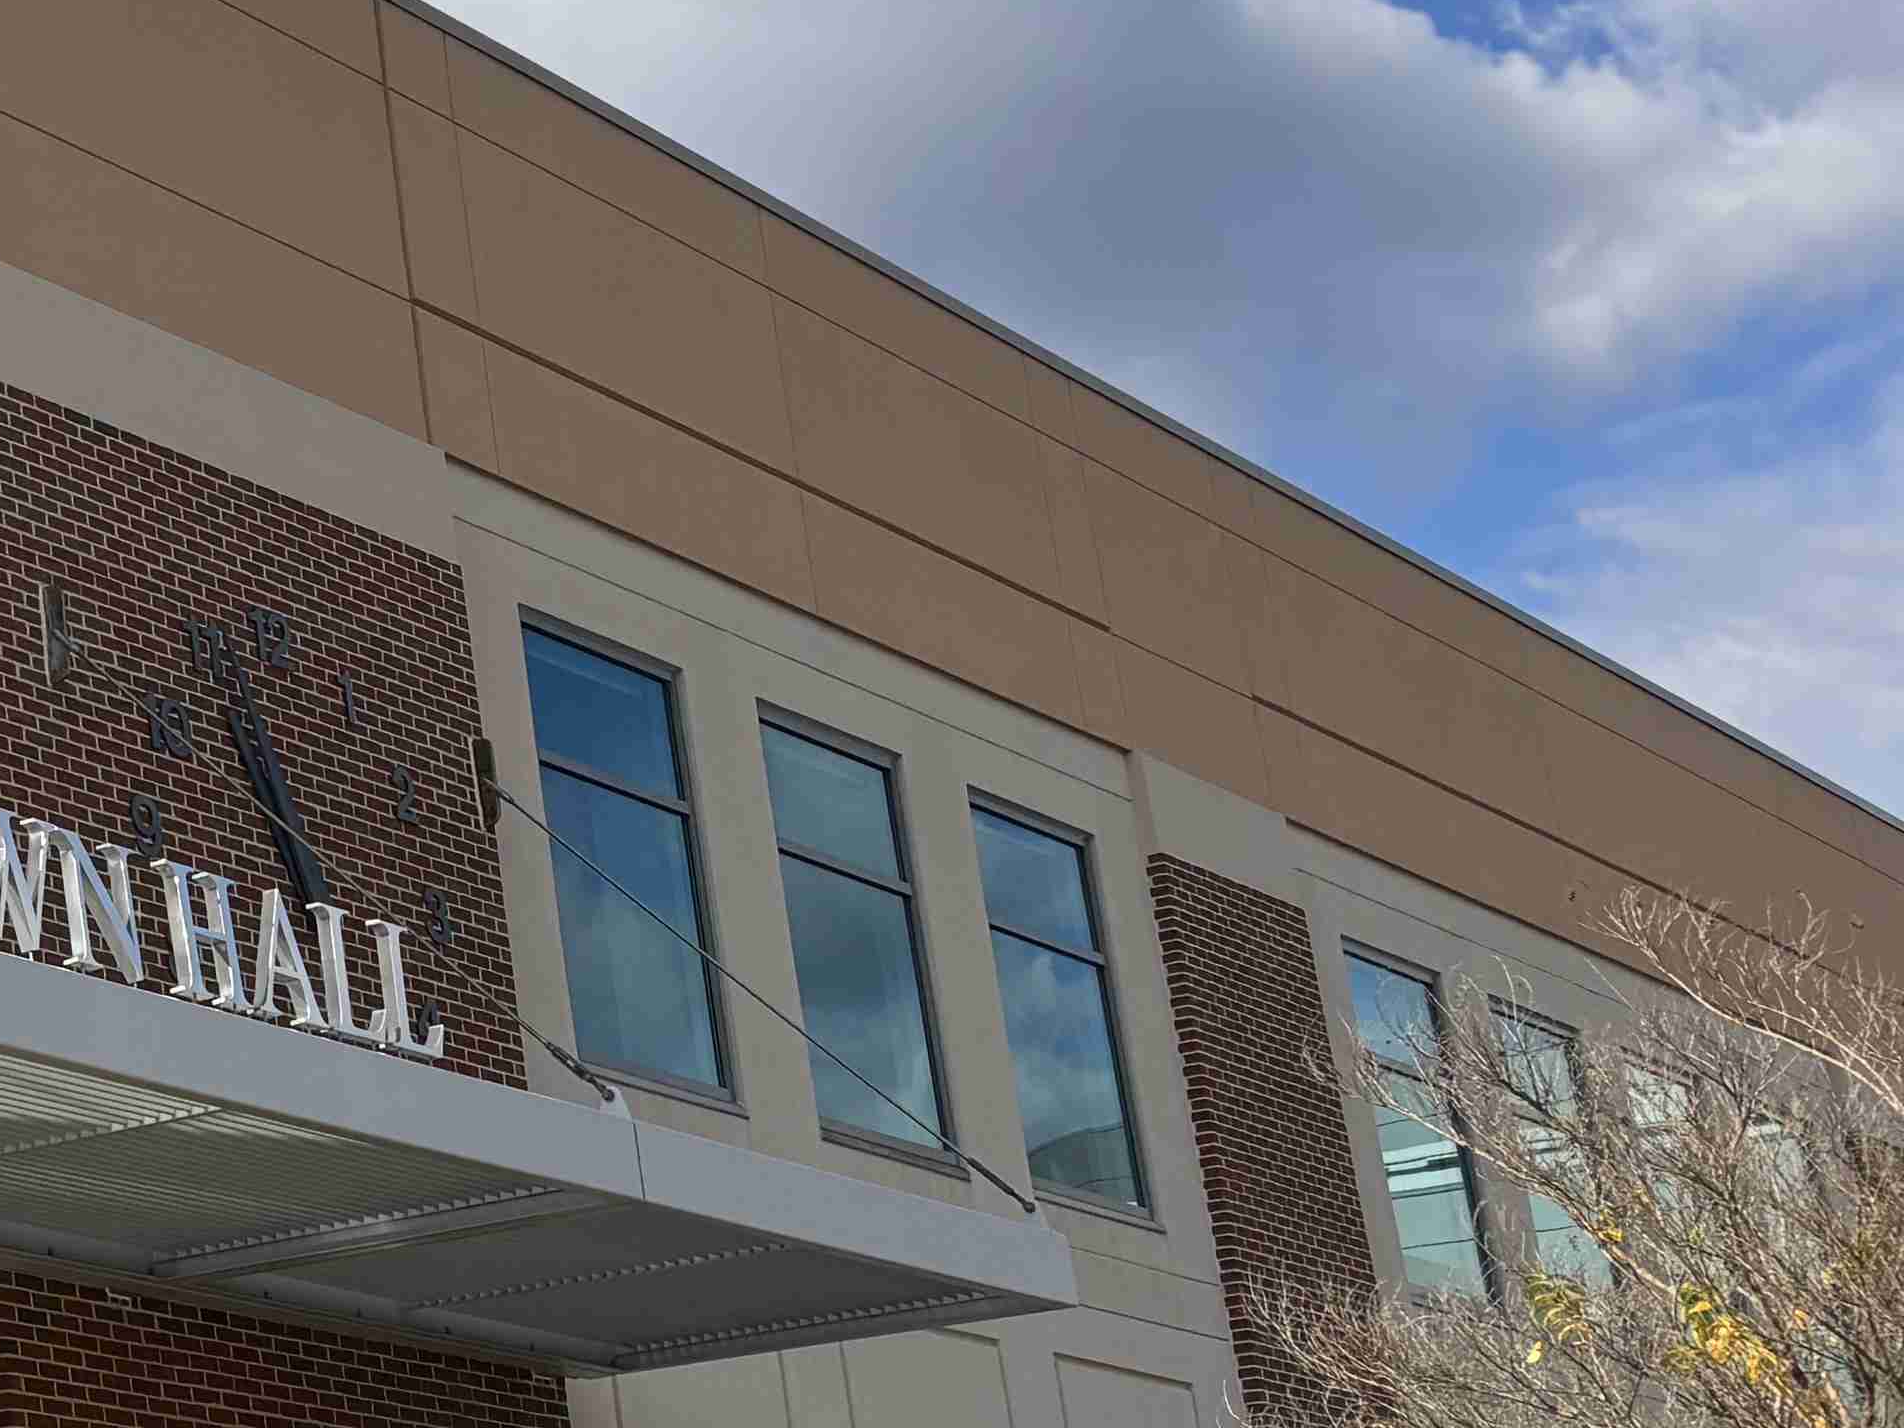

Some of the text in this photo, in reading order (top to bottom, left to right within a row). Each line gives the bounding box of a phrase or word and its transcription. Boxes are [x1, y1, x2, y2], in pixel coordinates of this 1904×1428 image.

[246, 605, 289, 669] 12
[393, 764, 419, 823] 2
[129, 794, 164, 860] 9
[423, 890, 456, 945] 3
[149, 858, 444, 1059] HALL
